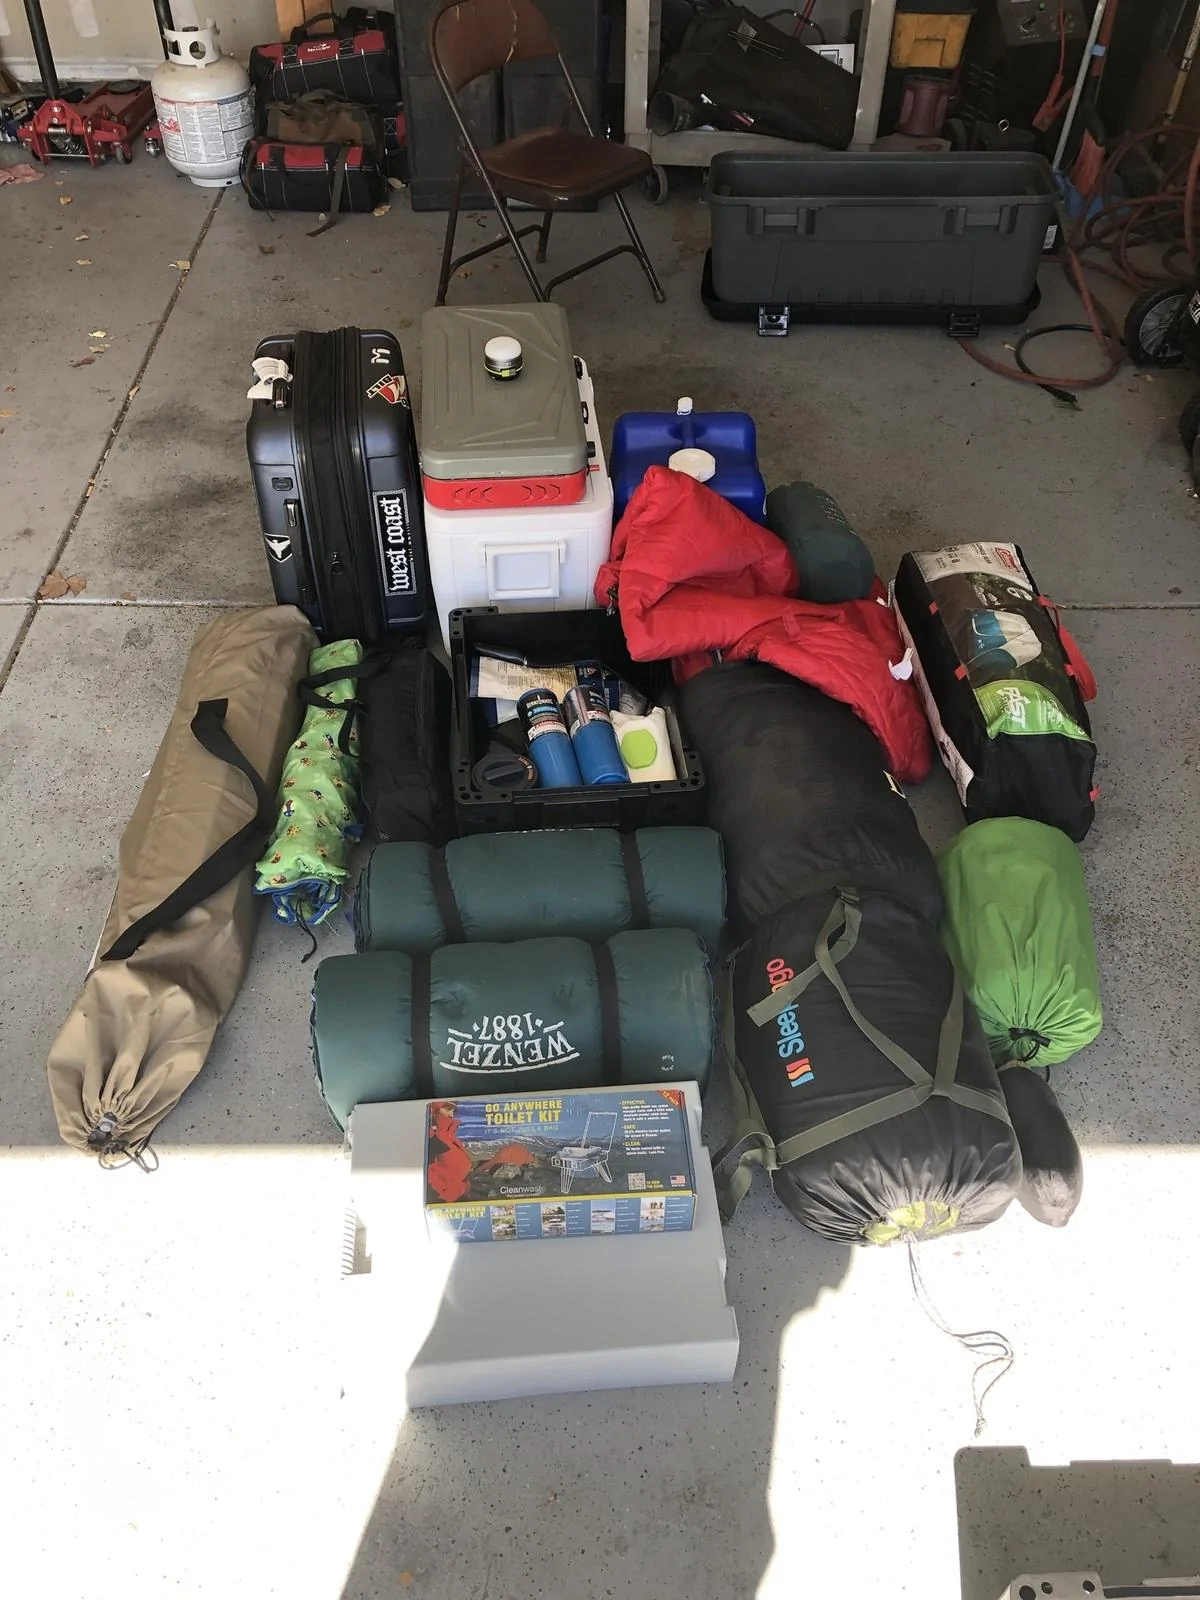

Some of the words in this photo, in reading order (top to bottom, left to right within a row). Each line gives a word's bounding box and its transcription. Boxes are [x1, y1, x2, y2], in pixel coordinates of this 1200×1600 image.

[367, 374, 393, 397] BILT
[378, 497, 406, 545] coast
[387, 547, 410, 591] west
[996, 686, 1031, 729] FAST
[479, 1013, 536, 1041] 1887
[447, 1031, 576, 1067] WENZEL
[485, 1103, 500, 1113] GO
[504, 1100, 562, 1112] ANYWHERE
[485, 1111, 534, 1126] TOILET
[539, 1109, 561, 1122] KIT
[500, 1184, 546, 1194] Cleanwaste
